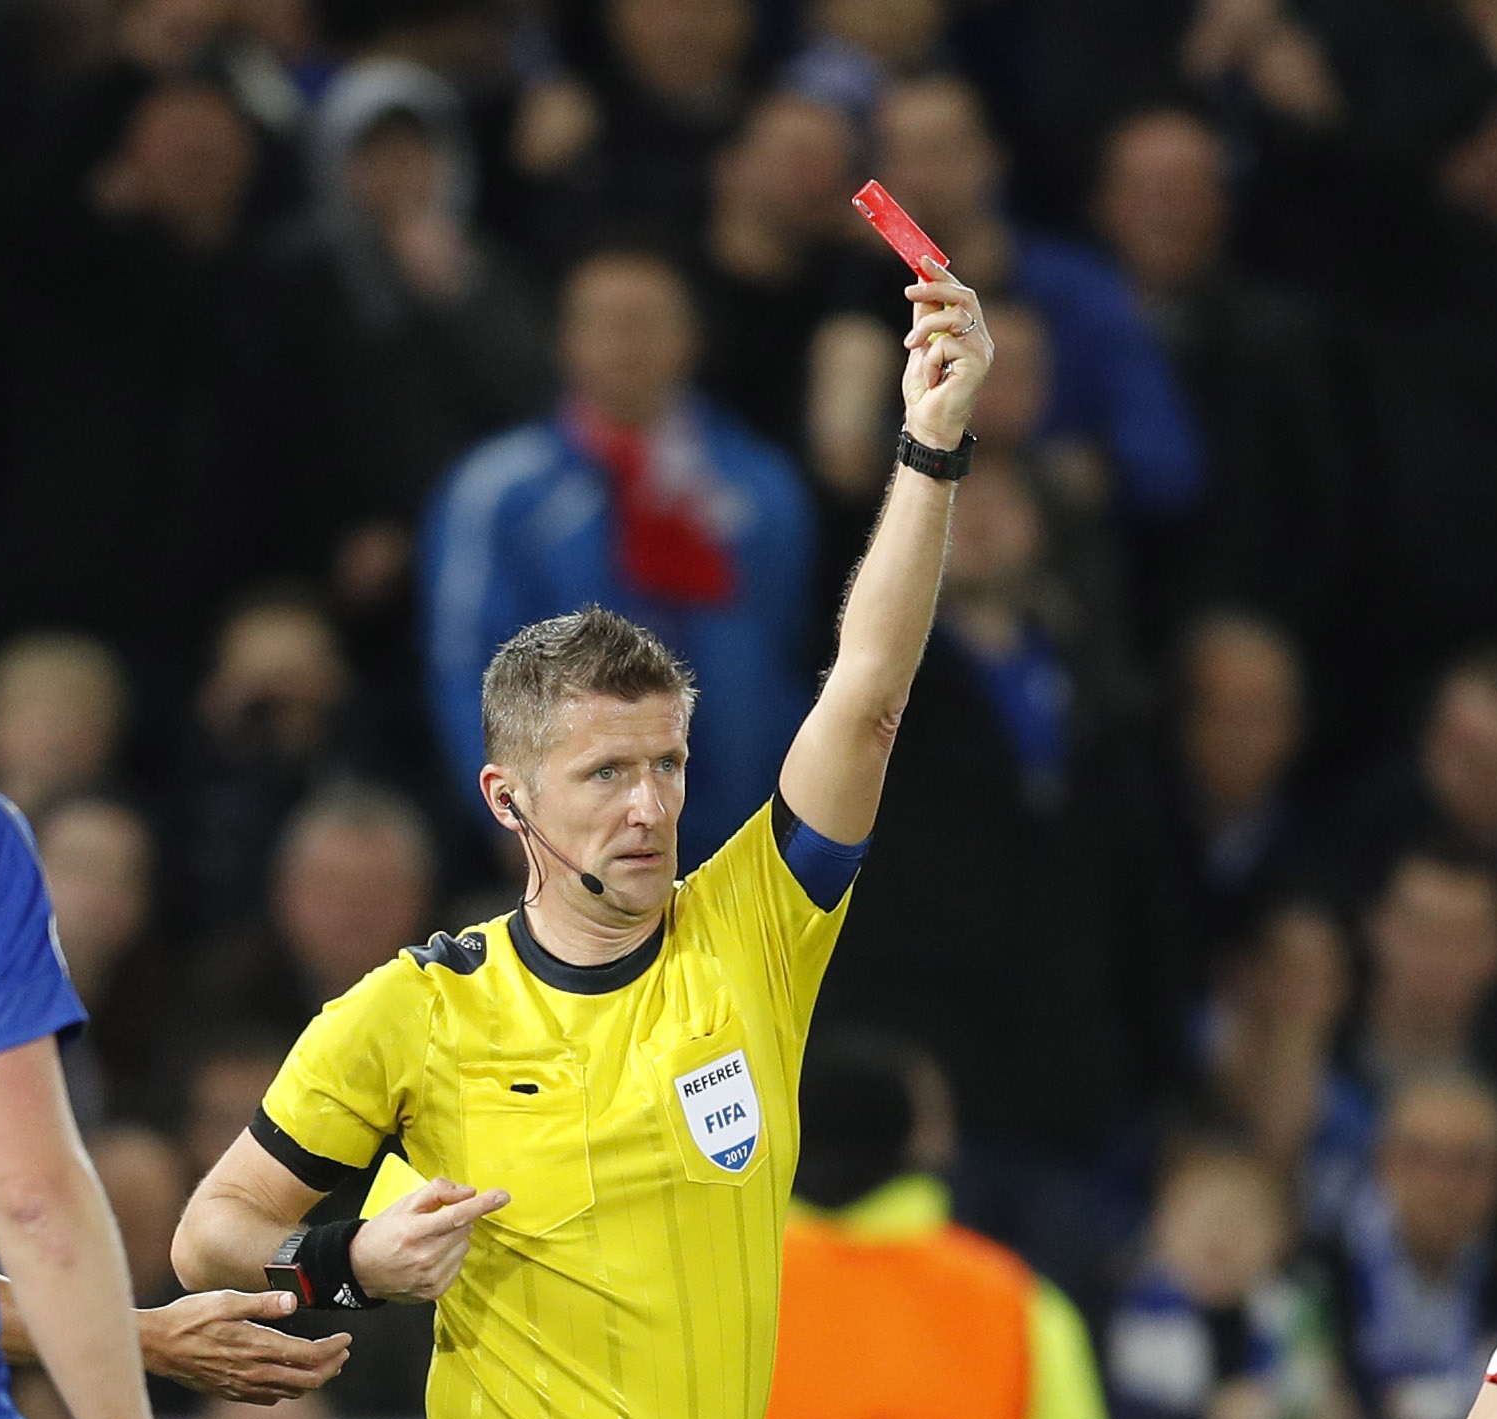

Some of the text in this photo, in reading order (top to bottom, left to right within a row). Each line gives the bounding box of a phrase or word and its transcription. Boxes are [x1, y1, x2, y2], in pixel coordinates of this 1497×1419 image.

[683, 1059, 742, 1098] REFEREE
[704, 1102, 746, 1134] FIFA
[724, 1145, 749, 1166] 2017
